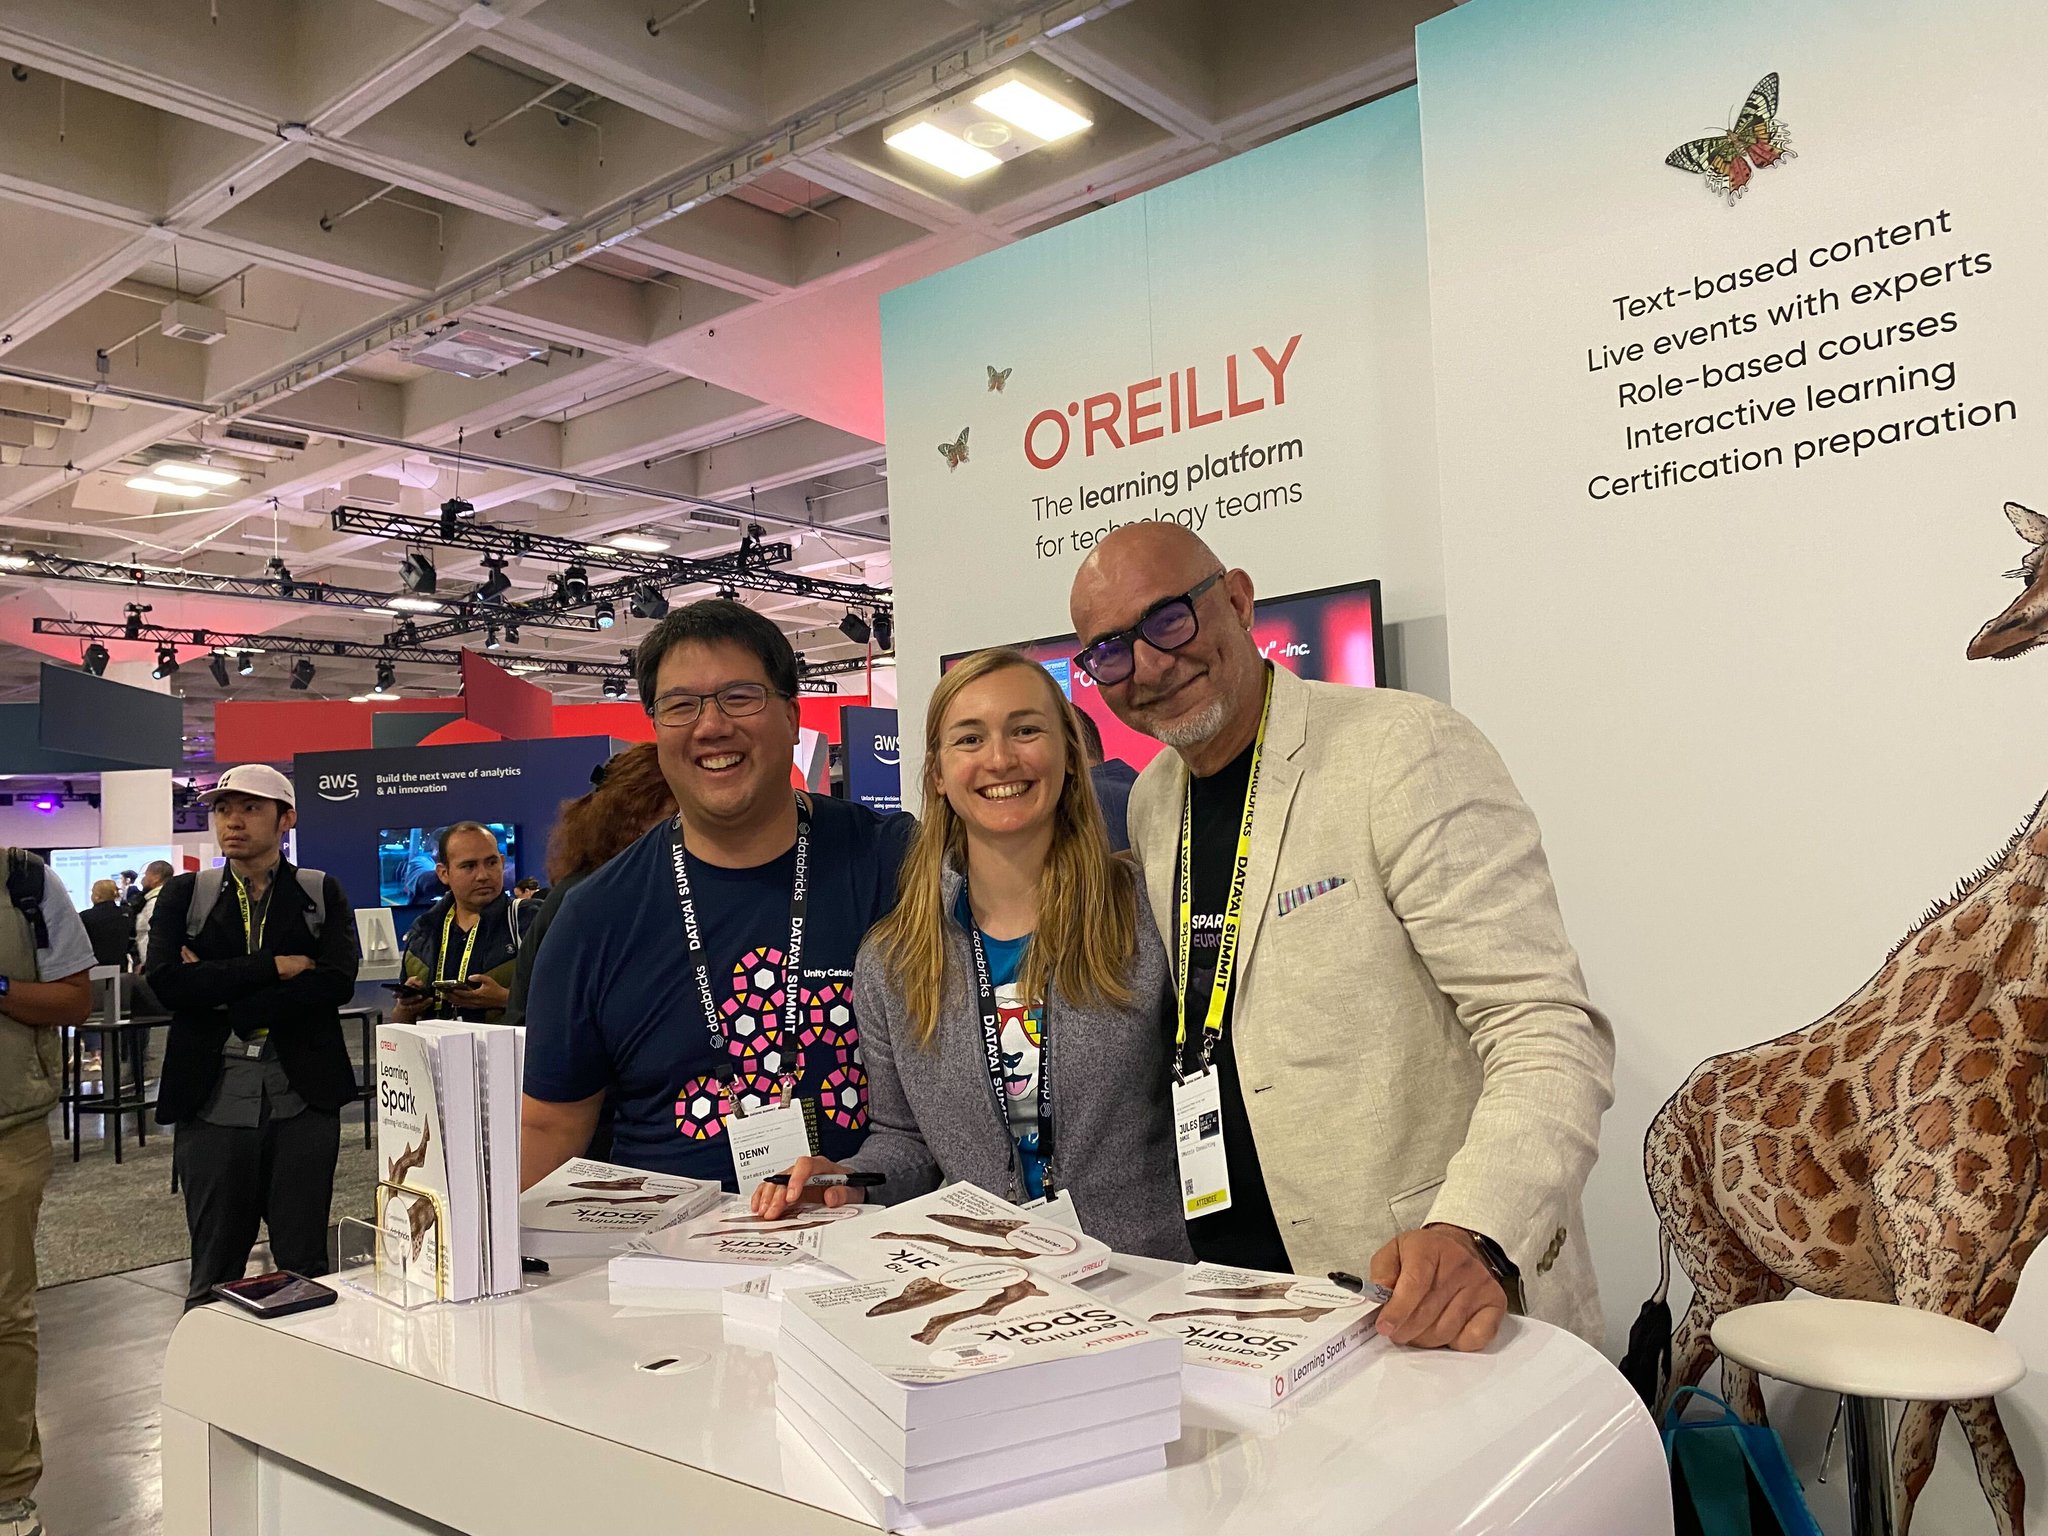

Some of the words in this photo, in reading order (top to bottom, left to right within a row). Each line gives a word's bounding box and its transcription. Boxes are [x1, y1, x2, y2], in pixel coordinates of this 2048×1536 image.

[1612, 249, 1797, 321] Text-based
[1808, 209, 1952, 268] content
[1588, 343, 1644, 372] Live
[1653, 310, 1758, 355] events
[1767, 288, 1840, 326] with
[1850, 252, 1992, 303] experts
[1617, 340, 1807, 408] Role-based
[1817, 312, 1958, 361] courses
[1023, 333, 1303, 469] O'REILLY
[1626, 397, 1796, 450] Interactive
[1806, 360, 1957, 411] learning
[1587, 440, 1783, 500] Certification
[1794, 400, 2017, 468] preparation
[1032, 495, 1073, 522] The
[1079, 469, 1178, 511] learning
[1186, 438, 1303, 492] platform
[1035, 535, 1065, 559] for
[1215, 482, 1303, 519] teams
[318, 773, 358, 790] aws
[376, 773, 400, 784] Build
[402, 772, 417, 782] the
[419, 771, 440, 781] next
[442, 771, 466, 780] wave
[468, 769, 478, 779] of
[480, 766, 521, 780] analytics
[376, 787, 384, 796] &
[386, 786, 397, 795] AI
[398, 784, 447, 795] innovation
[672, 843, 690, 896] SUMMIT
[793, 836, 810, 901] databricks
[1191, 914, 1224, 929] SPAR
[803, 969, 827, 979] Unity
[828, 968, 853, 977] Catalo
[972, 930, 990, 998] databricks
[1179, 921, 1189, 997] databricks
[1215, 923, 1236, 991] SUMMIT
[695, 965, 719, 1033] databricks
[784, 974, 798, 1034] SUMMIT
[380, 1061, 409, 1085] Learning
[381, 1080, 417, 1116] Spark
[1179, 1118, 1198, 1135] JULES
[738, 1145, 770, 1161] DENNY
[569, 1208, 658, 1221] Spark
[578, 1217, 650, 1226] Learning
[717, 1248, 792, 1257] Learning
[974, 1310, 1116, 1343] Spark
[1019, 1320, 1134, 1346] Learning
[1083, 1329, 1149, 1349] O'REILLY
[1178, 1325, 1298, 1353] Spark
[1184, 1339, 1281, 1361] Learning
[1199, 1356, 1263, 1370] O'REILLY
[1293, 1351, 1326, 1383] Learning
[1326, 1336, 1348, 1361] Spark
